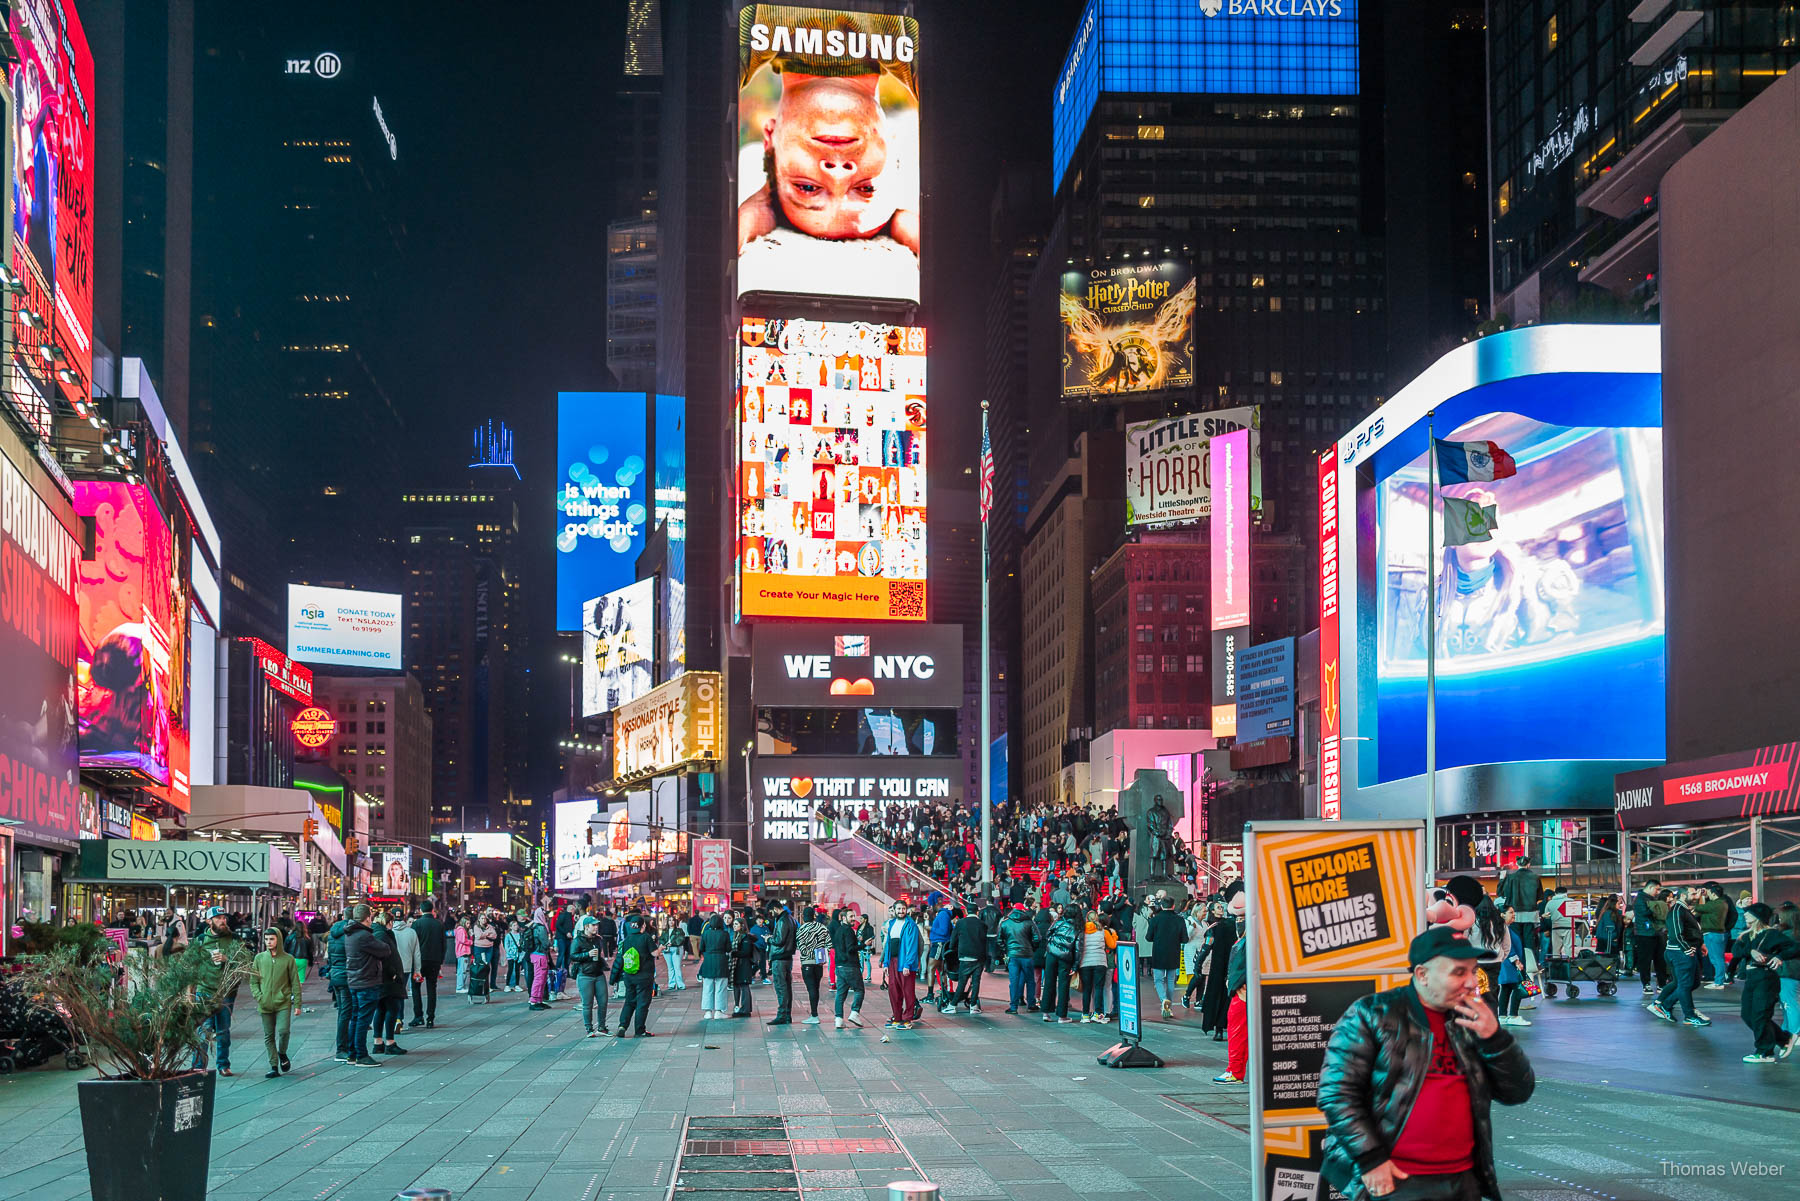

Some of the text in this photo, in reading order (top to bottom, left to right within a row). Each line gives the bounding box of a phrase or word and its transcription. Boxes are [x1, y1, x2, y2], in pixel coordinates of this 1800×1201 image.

[1228, 0, 1342, 16] BARCLAYS
[750, 24, 914, 62] SAMSUNG
[1066, 9, 1093, 90] BARCLAYS
[284, 60, 310, 73] nz
[1086, 278, 1170, 309] Harry Potter
[1102, 302, 1154, 314] CURSED CHILD
[1140, 418, 1248, 458] LITTLE SHO
[1356, 416, 1385, 450] PS5
[1184, 442, 1197, 451] OF
[565, 482, 630, 499] is when
[564, 501, 620, 520] things
[1135, 512, 1166, 520] Westside
[1168, 508, 1195, 518] Theatre
[2, 459, 80, 604] BROADWAY'S
[564, 520, 638, 540] go right.
[1322, 472, 1336, 618] COME INSIDE!
[1, 540, 40, 646] SURE
[760, 590, 880, 602] Create Your Magic Here
[301, 608, 325, 619] nsla
[338, 608, 368, 616] DONATE
[296, 645, 391, 659] SUMMERLEARNING.ORG
[784, 655, 934, 679] WE NYC
[292, 674, 312, 694] PLAZA
[304, 711, 323, 720] HOT
[622, 697, 680, 736] MISSIONARY STYLE
[697, 678, 714, 756] HELLO!
[303, 735, 324, 744] NOW
[763, 777, 949, 797] WE THAT IF YOU CAN
[1680, 772, 1769, 795] 1568 BROADWAY
[0, 753, 80, 836] CHICAGO
[108, 802, 123, 824] BLUE
[764, 800, 809, 818] MAKE
[764, 821, 809, 839] MAKE
[111, 848, 266, 872] SWAROVSKI
[701, 843, 724, 889] tkts
[1290, 847, 1371, 885] EXPLORE
[1294, 876, 1348, 908] MORE
[1299, 893, 1377, 930] IN TIMES
[1304, 917, 1378, 953] SQUARE
[1272, 995, 1306, 1004] THEATERS
[1273, 1042, 1316, 1051] LUNT-FONTANNE
[1273, 1061, 1297, 1070] SHOPS
[1278, 1172, 1304, 1181] EXPLORE
